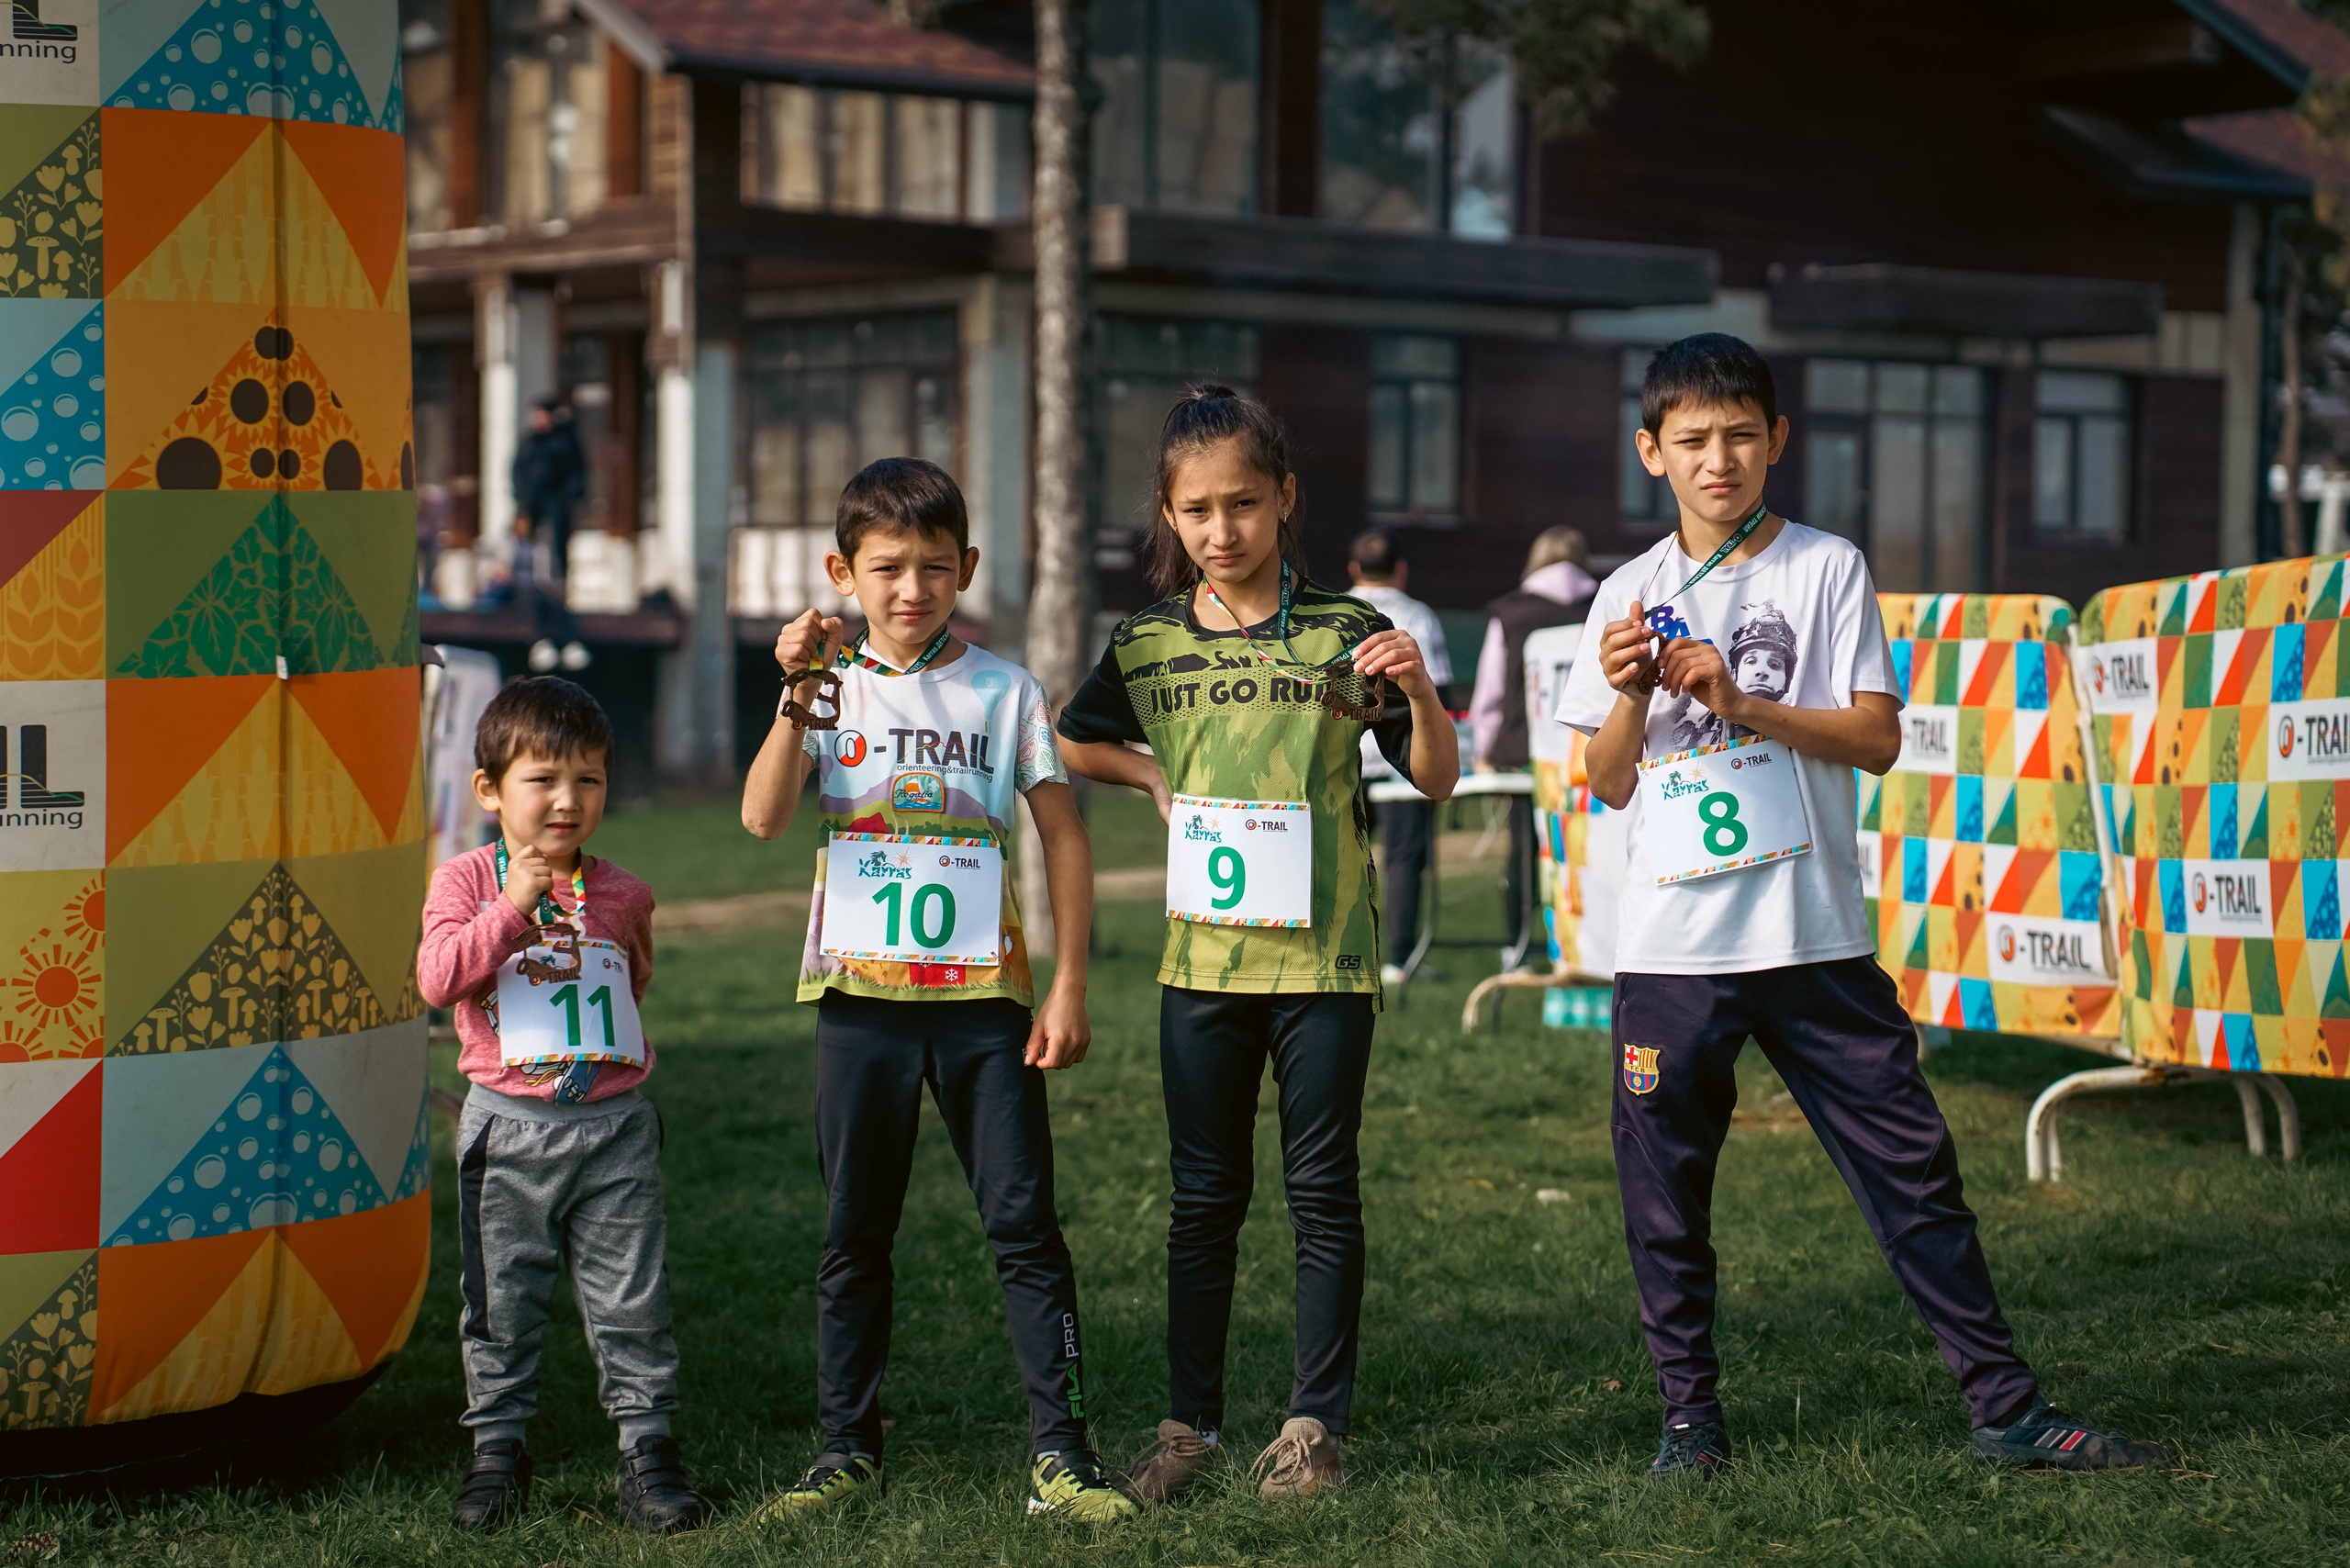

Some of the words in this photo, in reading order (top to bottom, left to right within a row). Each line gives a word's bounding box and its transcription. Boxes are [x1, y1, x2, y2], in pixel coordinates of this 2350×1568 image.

[1150, 683, 1200, 715] JUST
[1209, 678, 1258, 705] GO
[2278, 714, 2350, 758] O-TRAI
[1662, 779, 1709, 801] Karras
[0, 808, 84, 830] nning
[1185, 822, 1222, 843] Karras
[1698, 791, 1748, 857] 8
[858, 857, 912, 879] Karras
[1207, 846, 1246, 910] 9
[872, 881, 957, 949] 10
[549, 984, 616, 1047] 11
[1063, 1313, 1079, 1358] PRO
[1067, 1362, 1085, 1419] FILA
